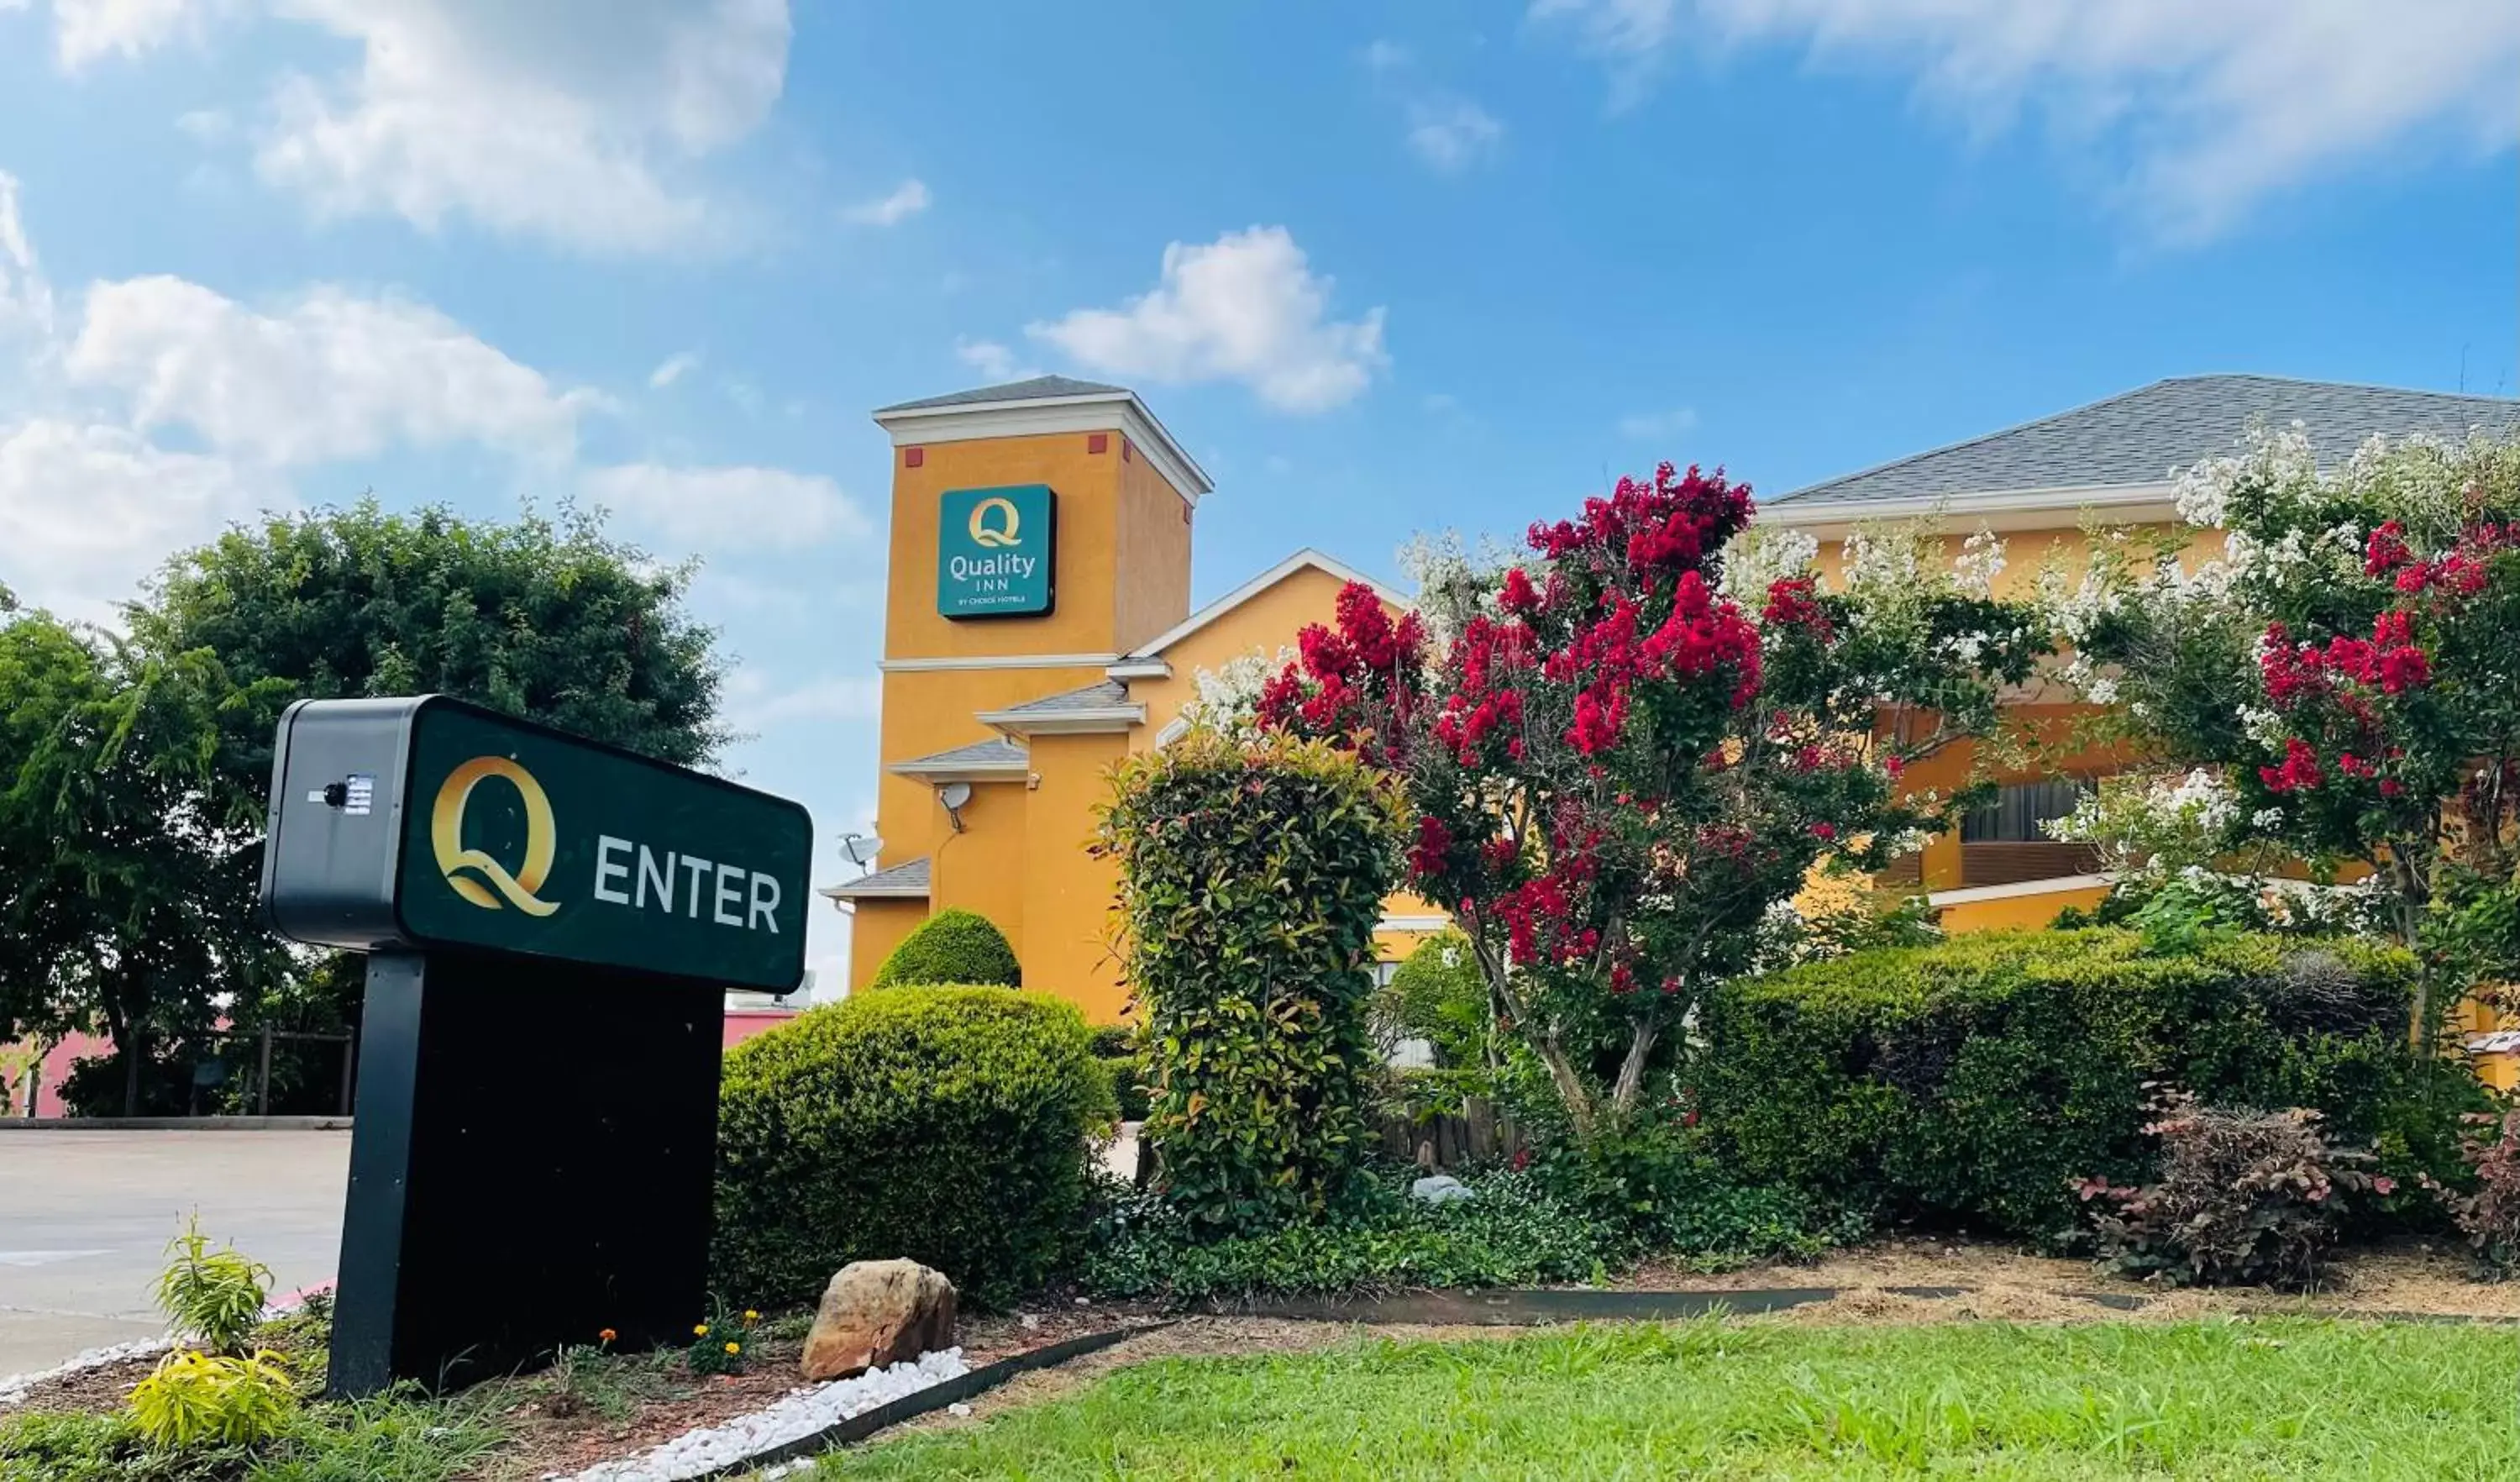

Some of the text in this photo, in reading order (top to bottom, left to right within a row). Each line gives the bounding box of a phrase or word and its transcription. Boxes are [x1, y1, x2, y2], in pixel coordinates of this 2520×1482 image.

[969, 497, 1021, 547] Q
[950, 554, 1035, 581] Quality
[976, 580, 1008, 592] INN
[431, 756, 561, 917] Q
[594, 834, 780, 933] ENTER
